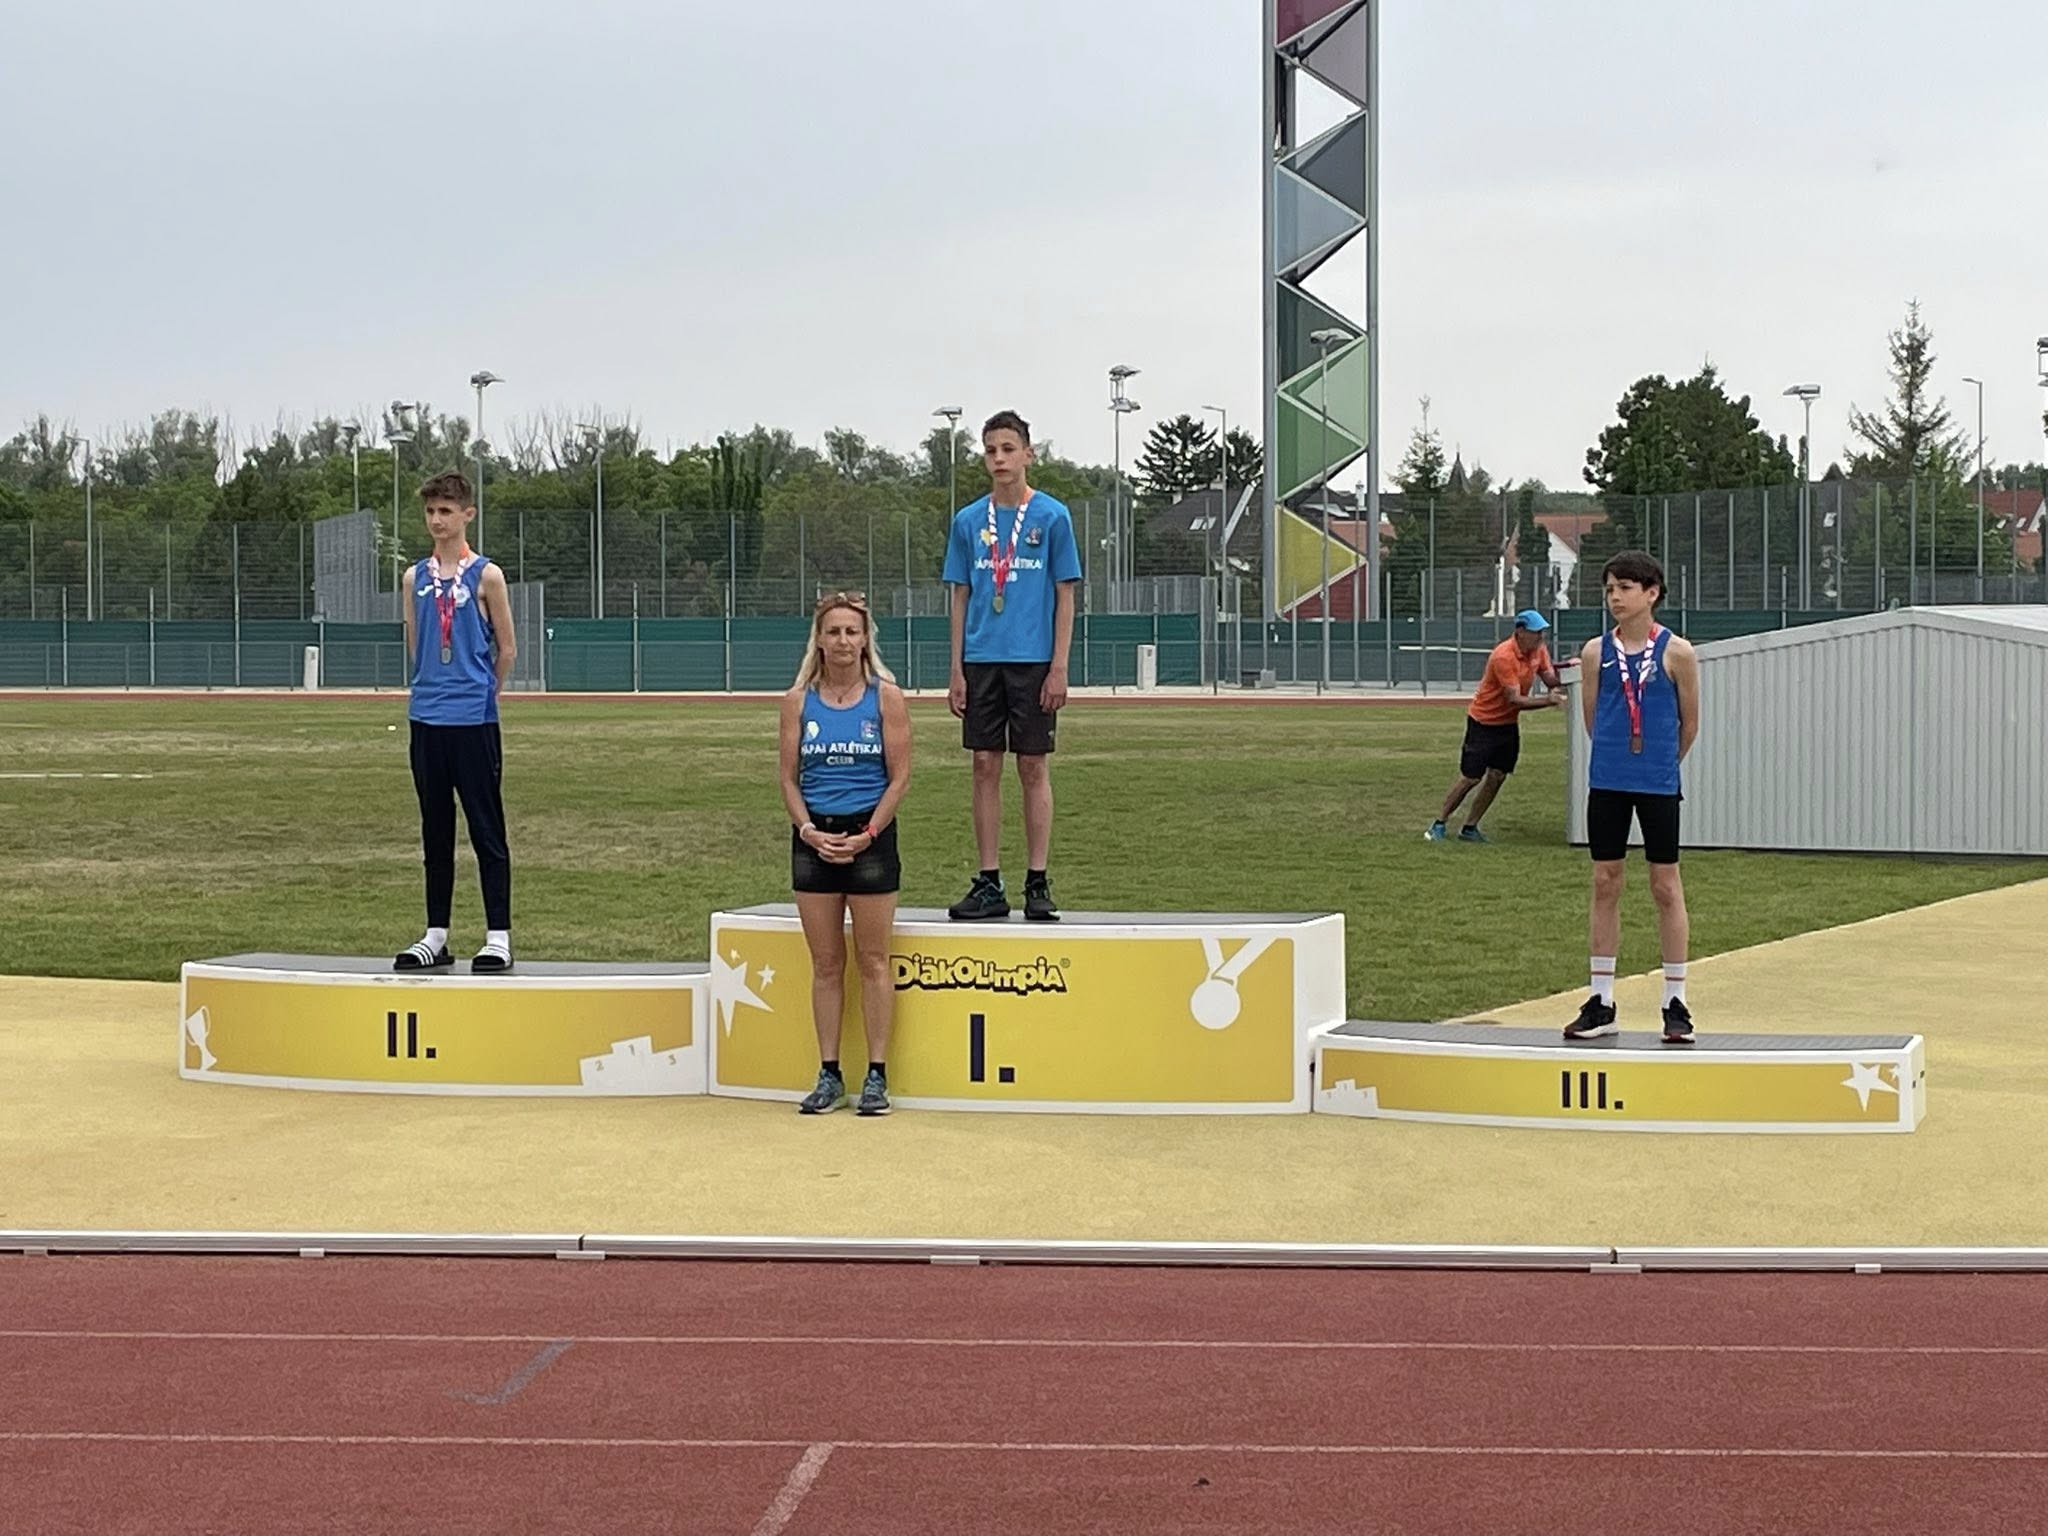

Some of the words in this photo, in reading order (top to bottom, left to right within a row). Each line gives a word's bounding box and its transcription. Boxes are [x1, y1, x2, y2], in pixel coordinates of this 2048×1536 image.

[387, 1011, 437, 1059] II.
[969, 1013, 1015, 1083] I.
[1561, 1070, 1624, 1110] III.
